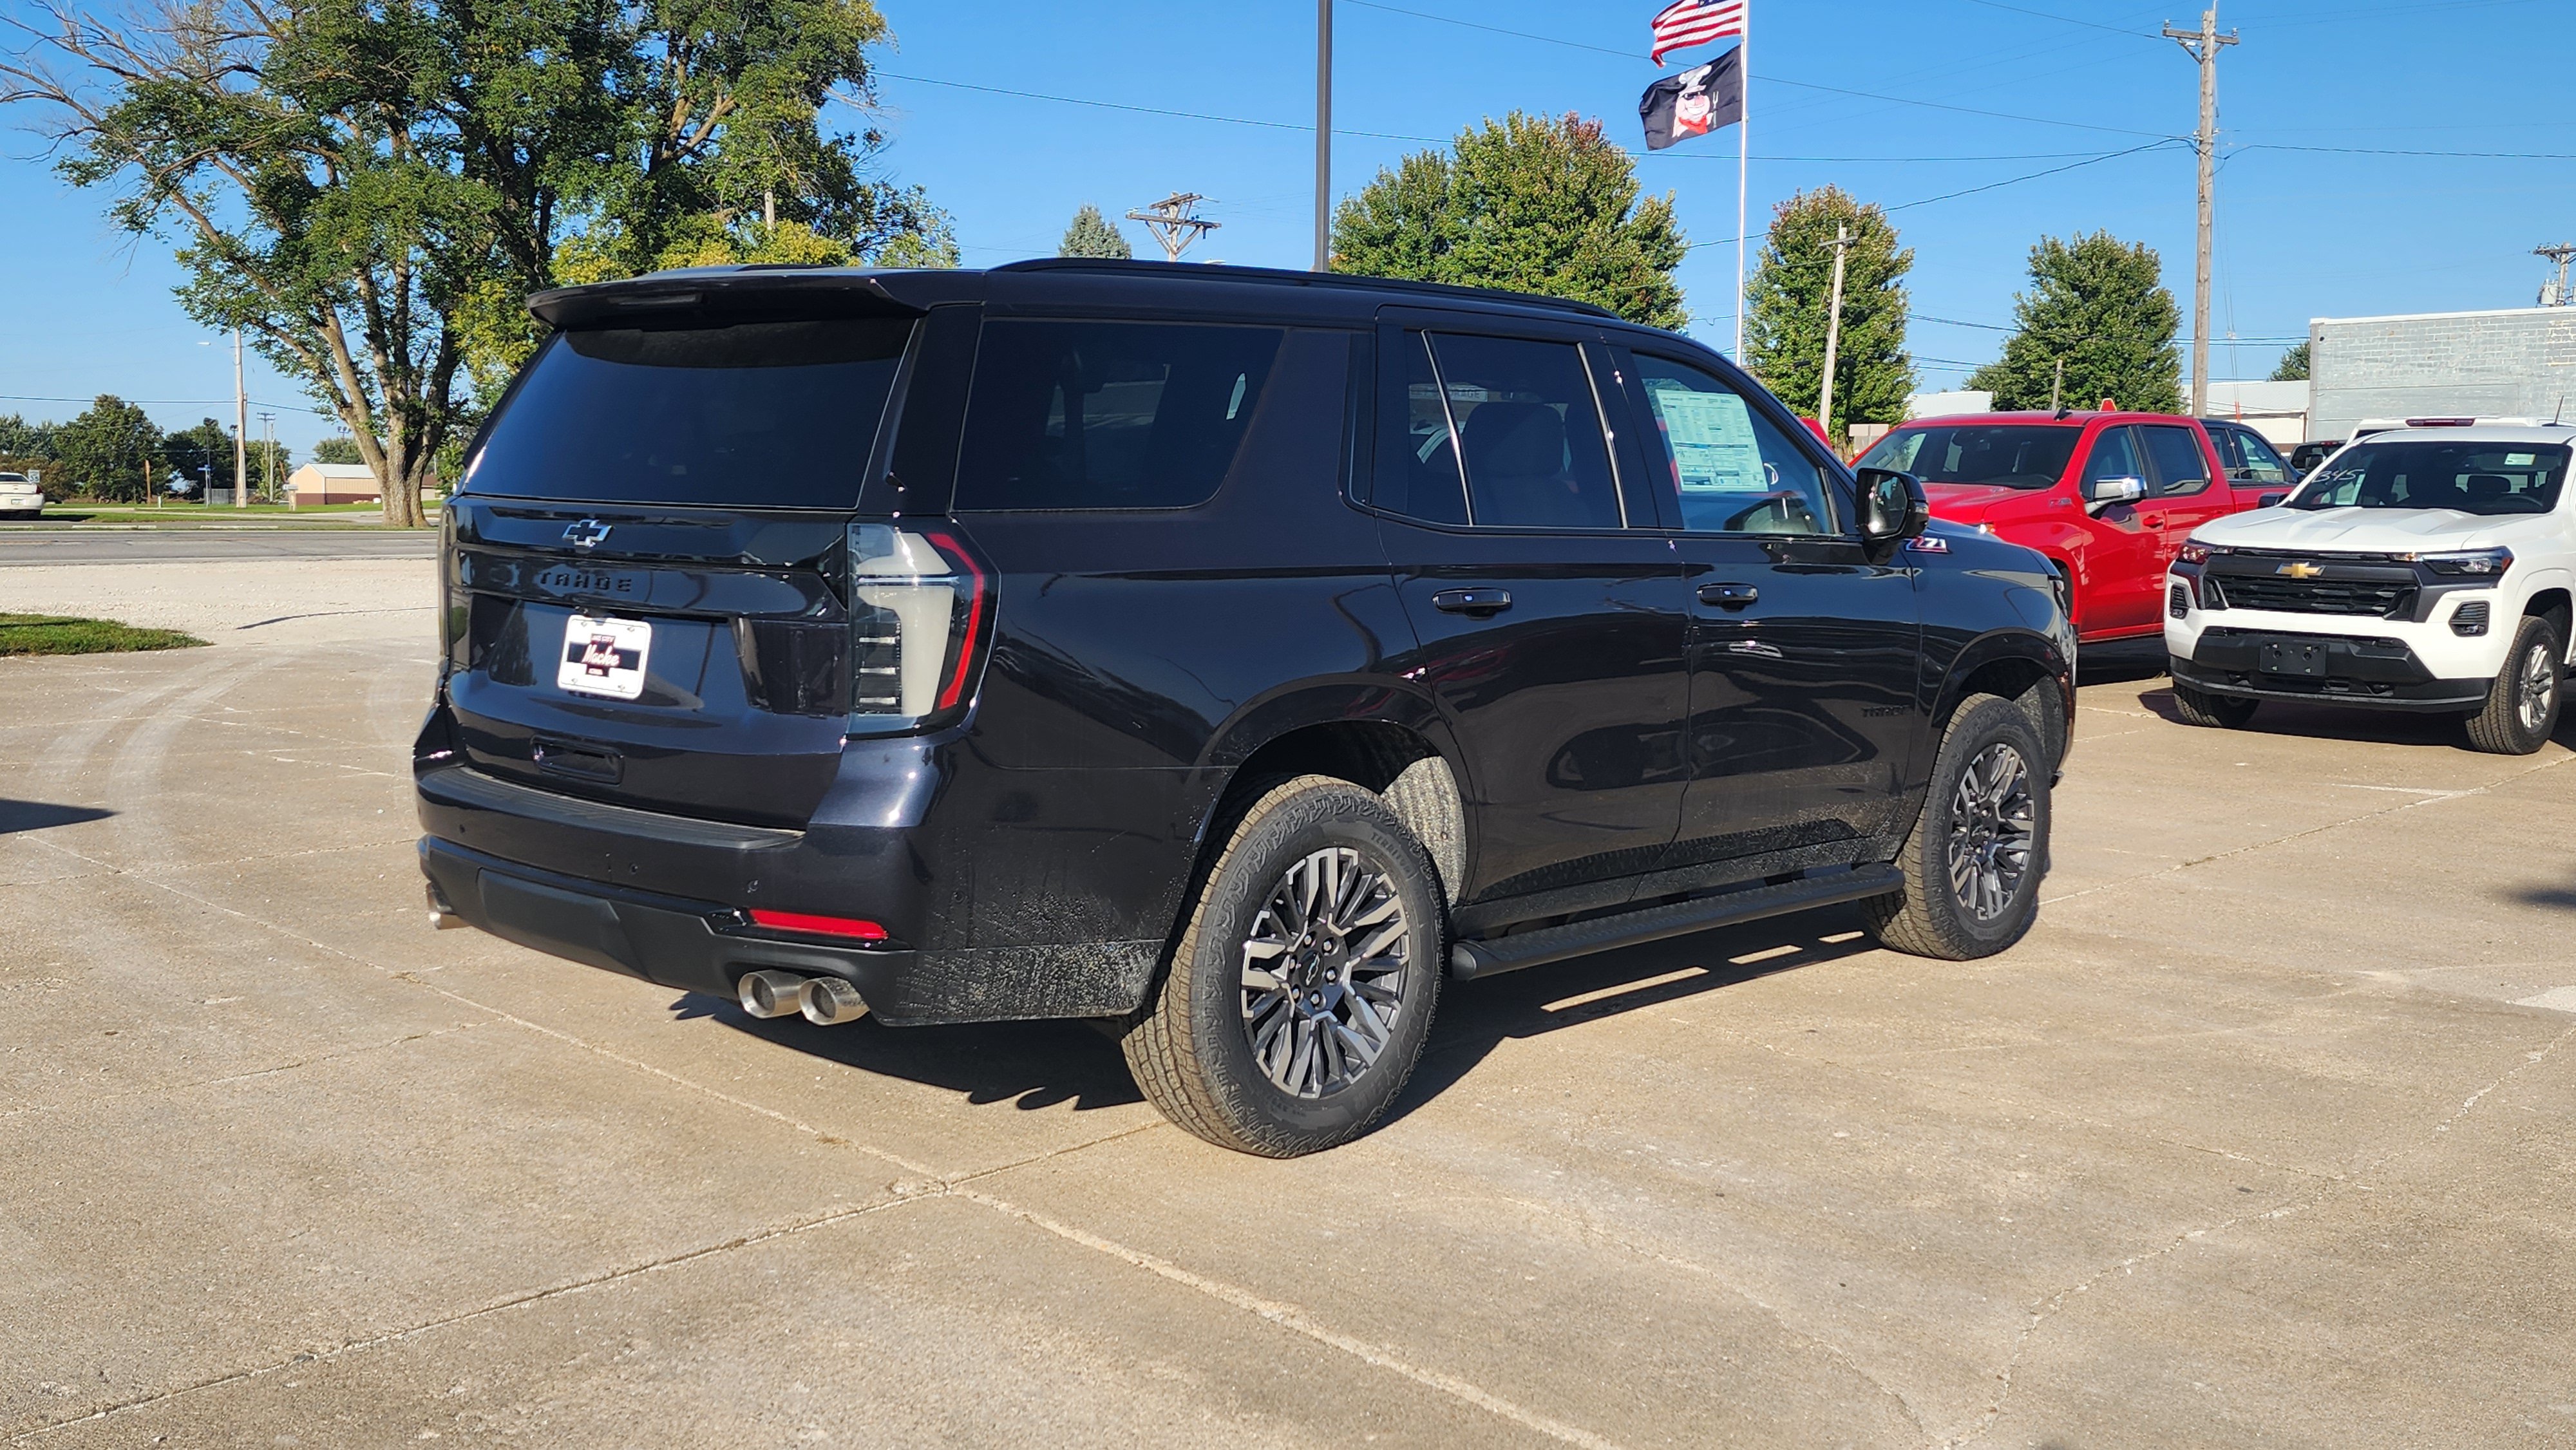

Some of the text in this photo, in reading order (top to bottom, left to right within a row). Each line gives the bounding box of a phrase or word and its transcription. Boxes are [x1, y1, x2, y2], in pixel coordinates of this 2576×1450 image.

[1903, 535, 1949, 553] Z71
[540, 572, 632, 592] TAHOE
[582, 643, 621, 667] Macke
